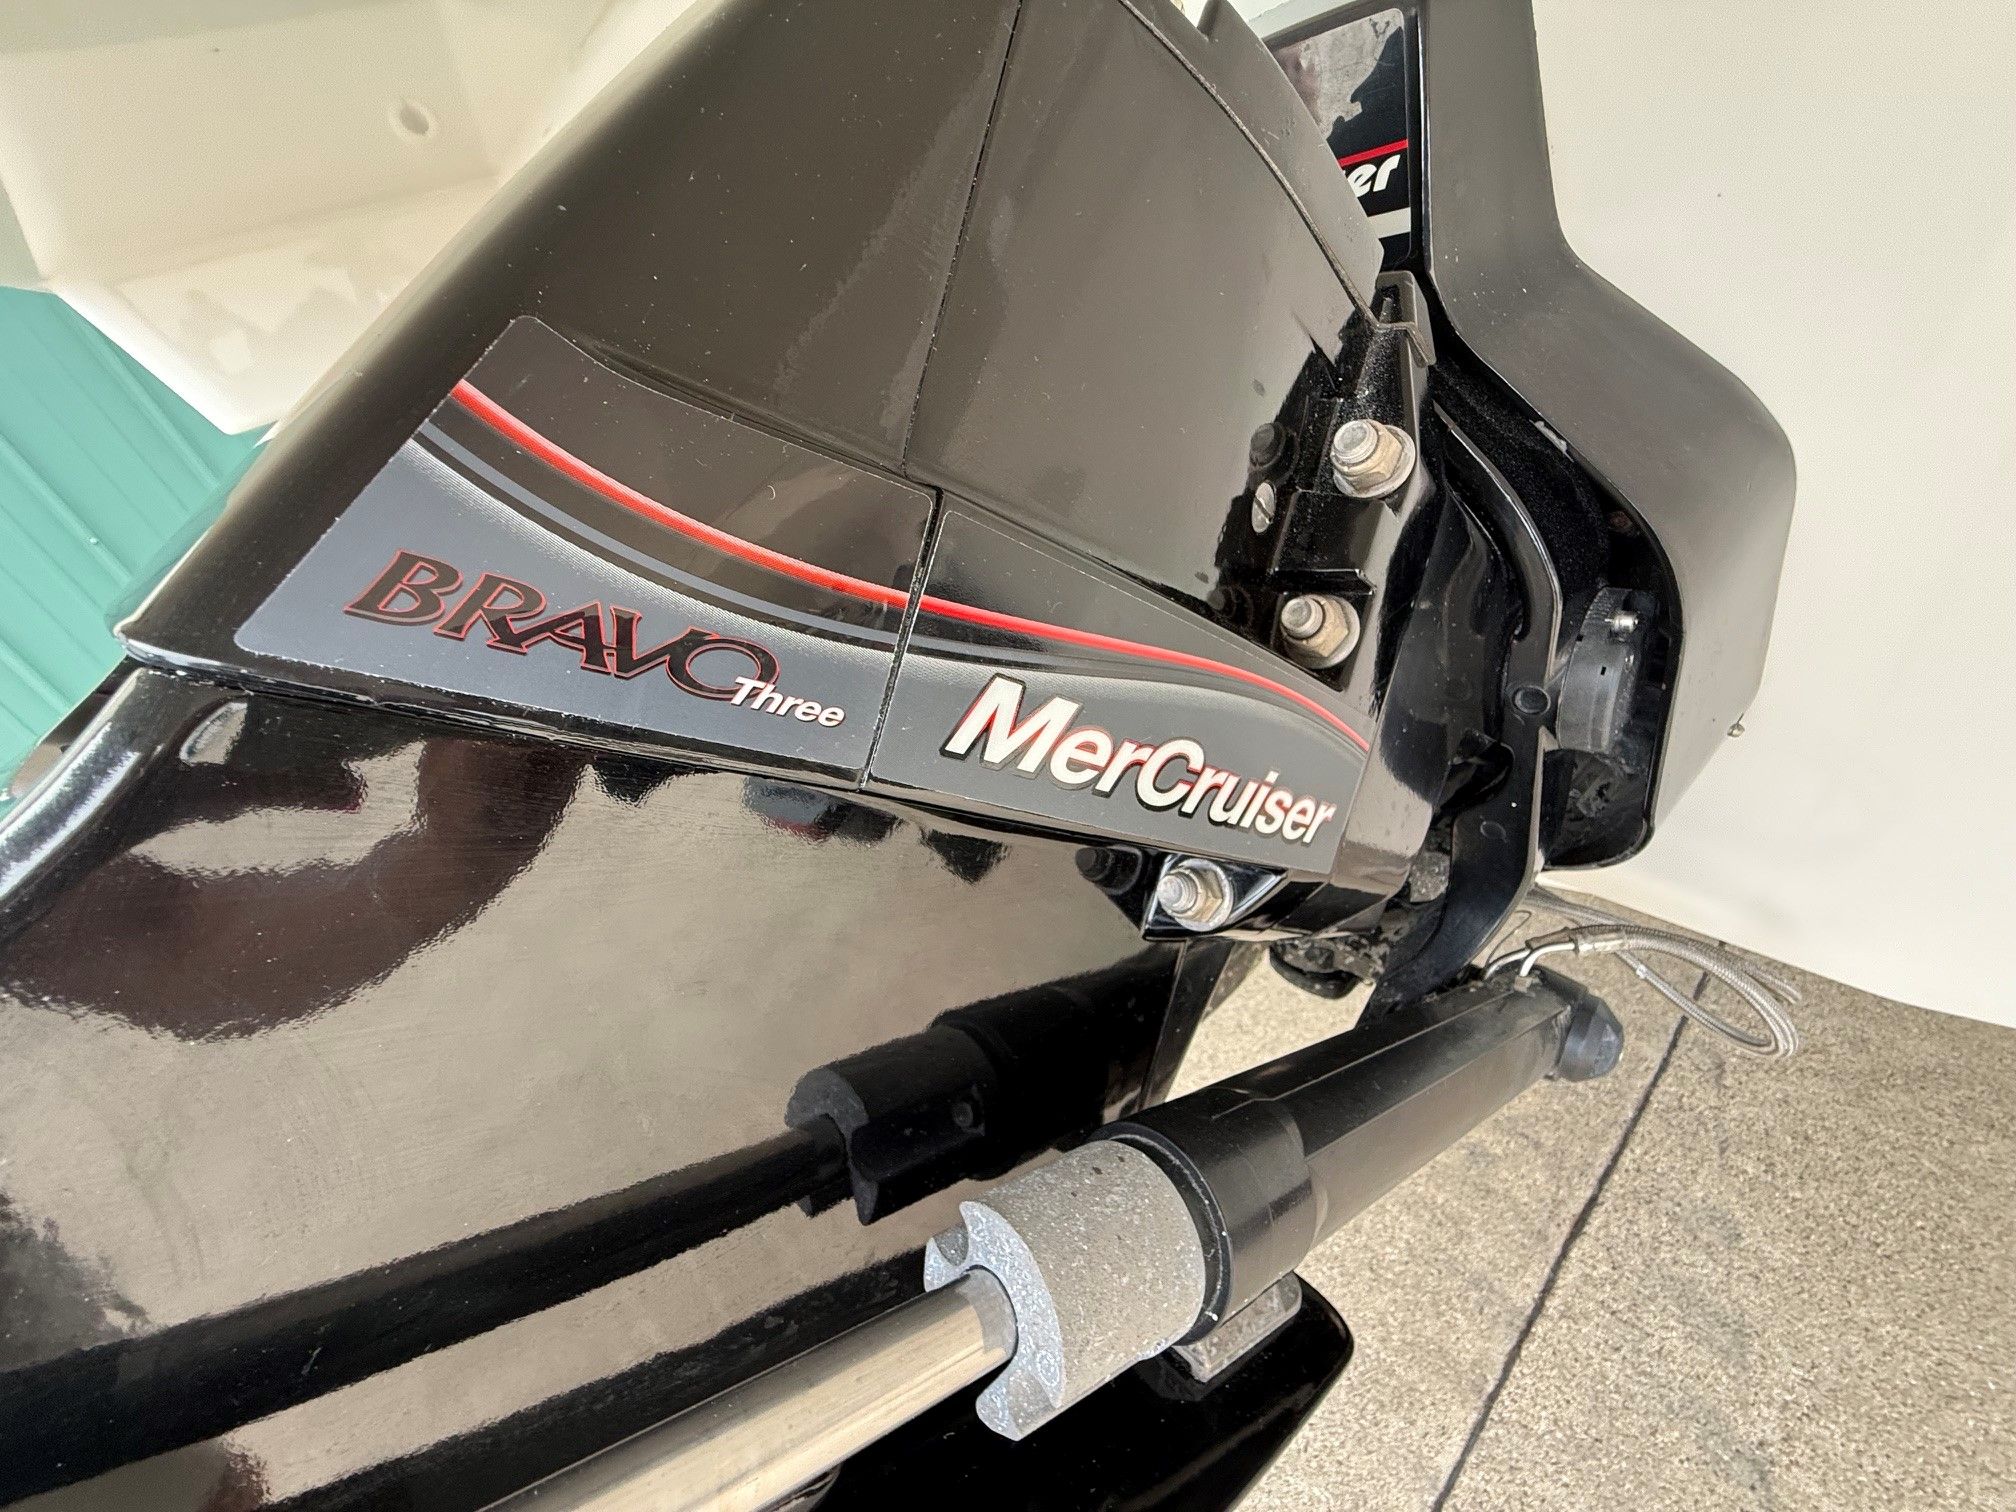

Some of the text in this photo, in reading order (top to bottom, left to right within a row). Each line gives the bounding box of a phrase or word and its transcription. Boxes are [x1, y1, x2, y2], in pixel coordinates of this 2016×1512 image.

[1343, 154, 1400, 198] er
[343, 549, 846, 728] BRAVO Three
[939, 672, 1337, 848] MerCruiser
